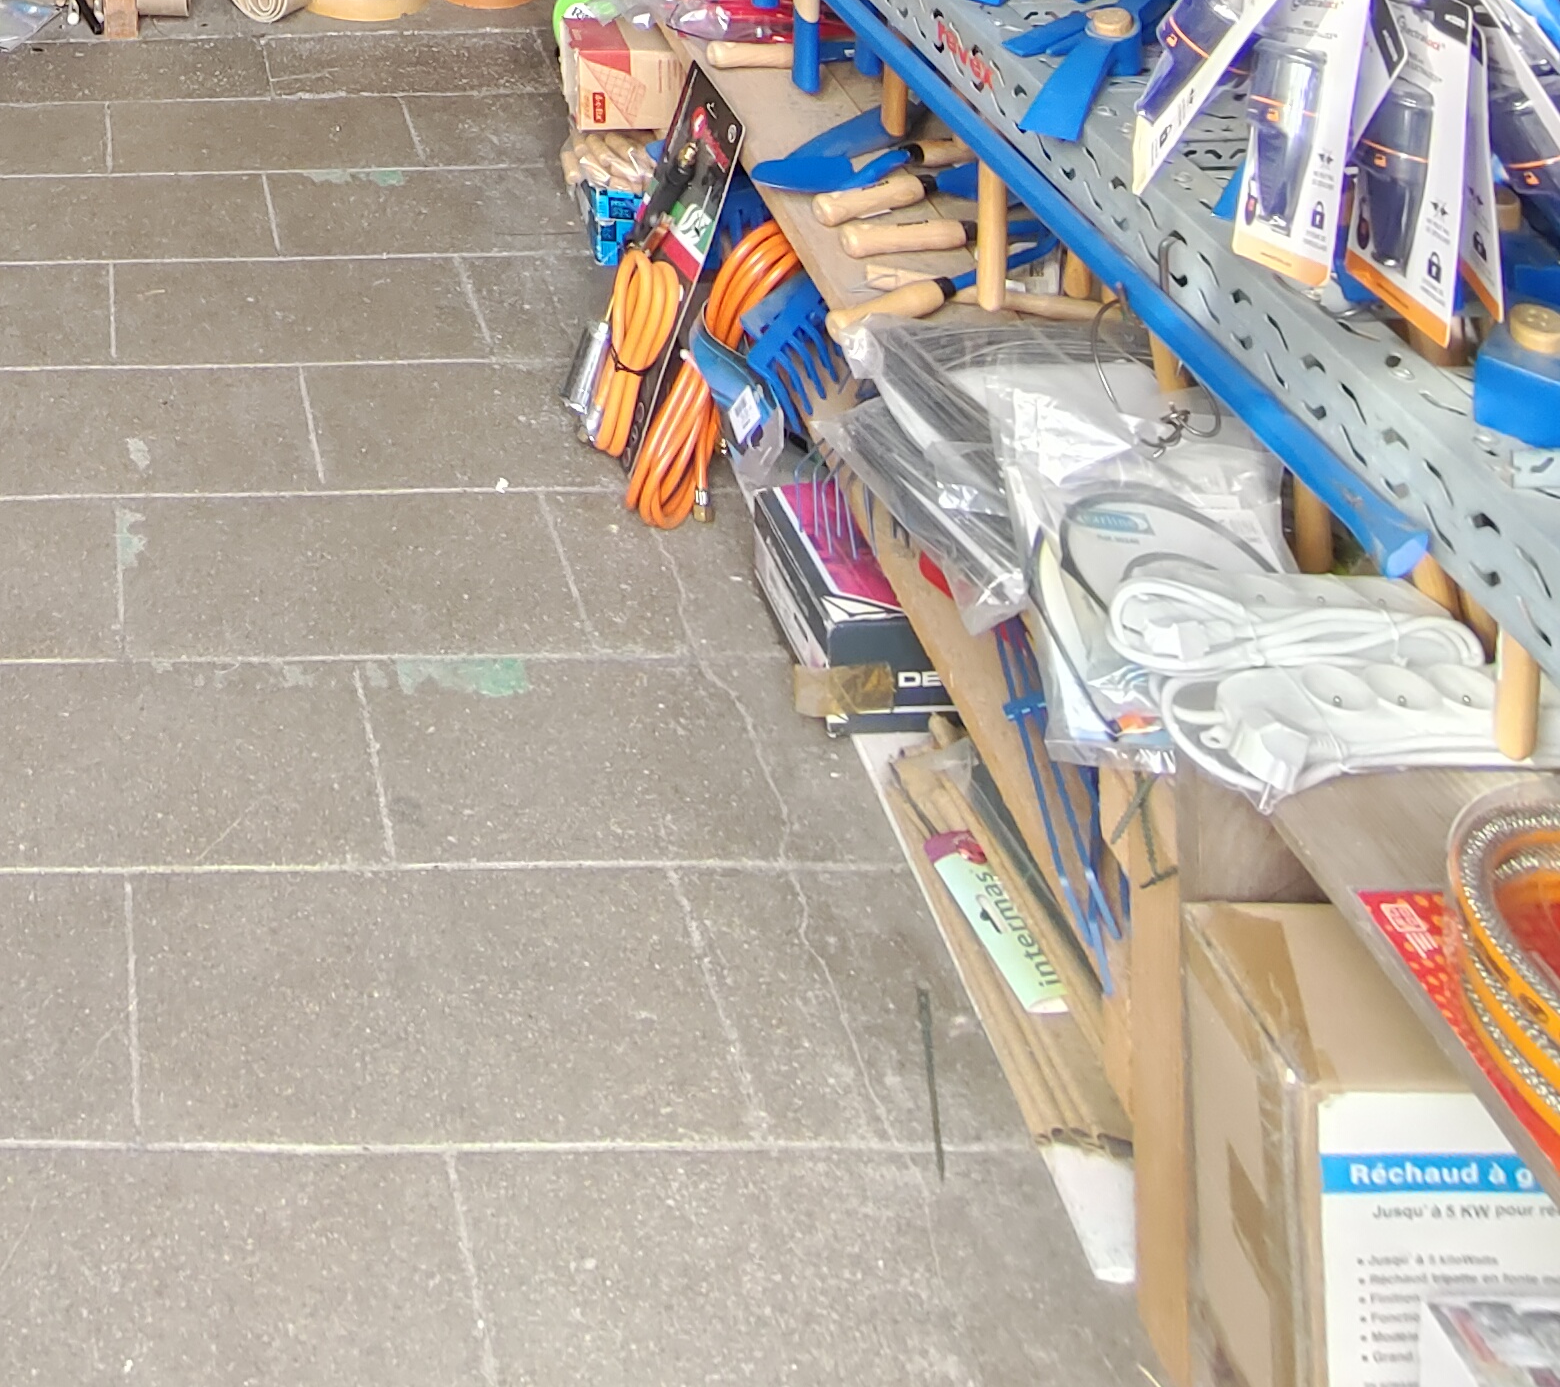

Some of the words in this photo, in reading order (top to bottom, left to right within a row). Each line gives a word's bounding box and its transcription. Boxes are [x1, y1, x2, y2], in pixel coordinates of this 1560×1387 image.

[897, 670, 943, 688] DE
[975, 871, 1062, 987] intermas
[1349, 1161, 1480, 1186] Réchaud
[1488, 1161, 1508, 1185] à
[1515, 1167, 1535, 1190] g
[1446, 1204, 1456, 1219] 5
[1461, 1204, 1491, 1218] KW
[1495, 1205, 1533, 1220] pour
[1539, 1202, 1560, 1217] ré
